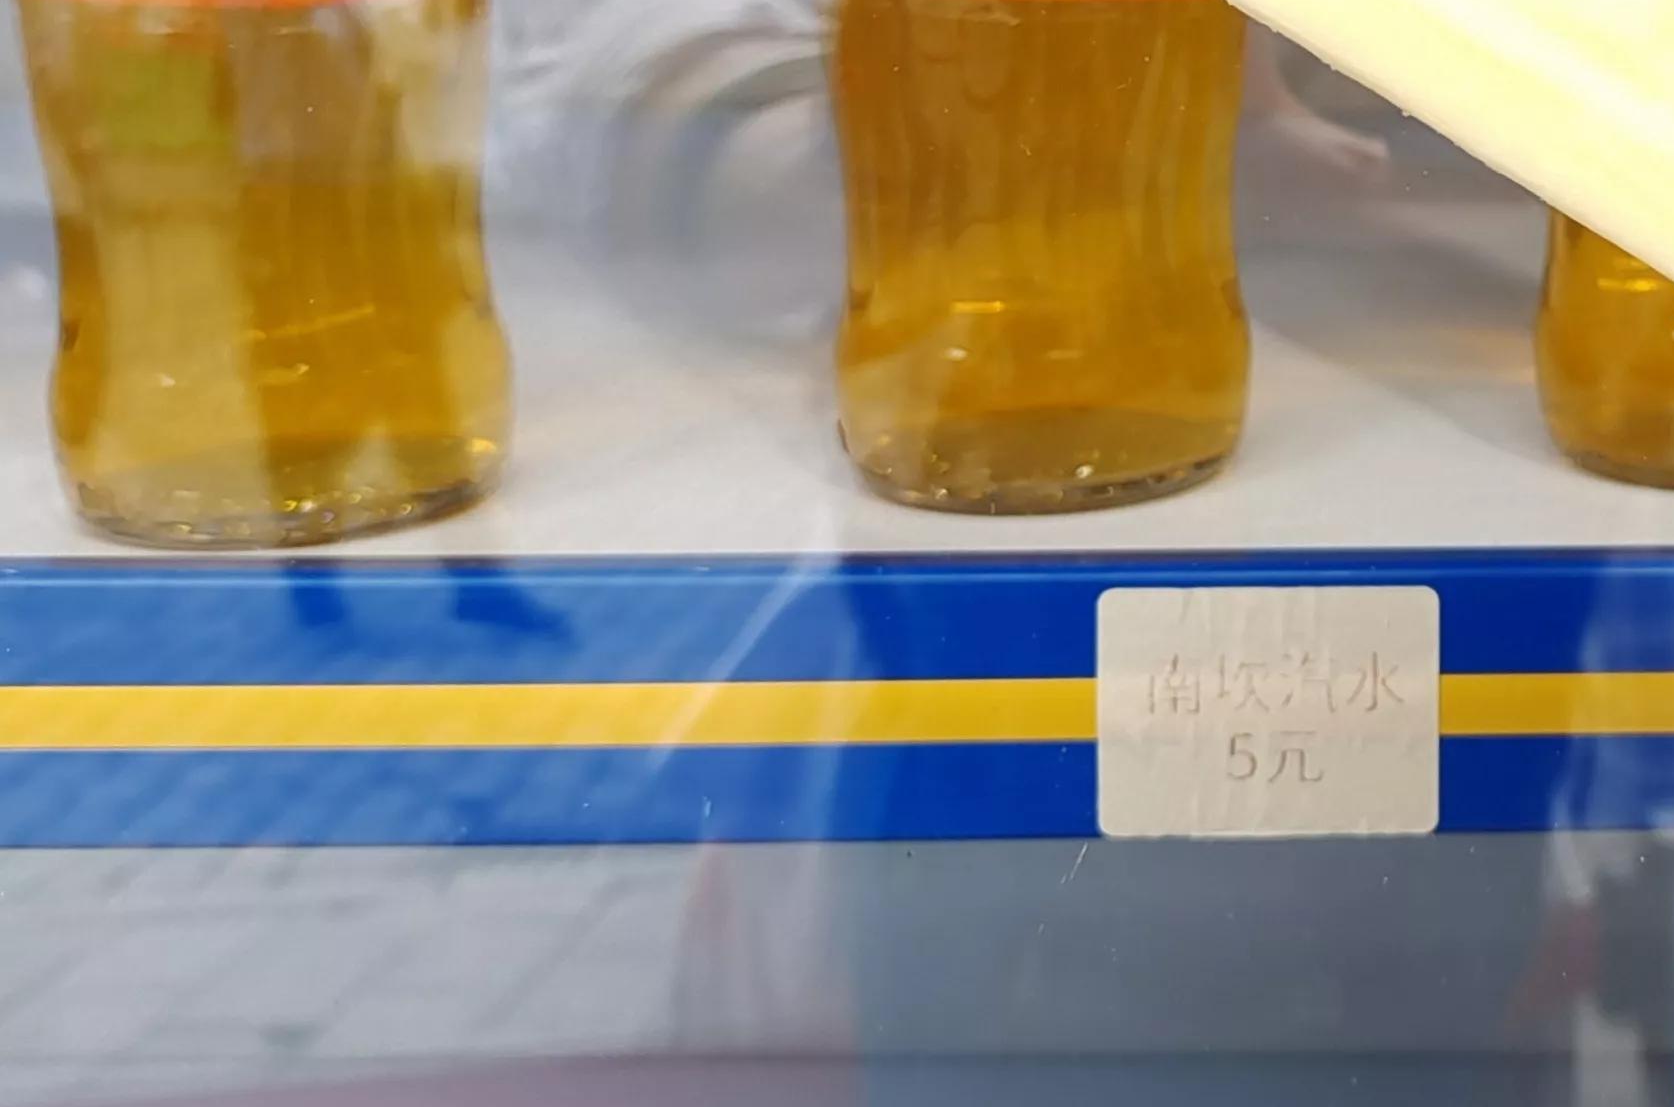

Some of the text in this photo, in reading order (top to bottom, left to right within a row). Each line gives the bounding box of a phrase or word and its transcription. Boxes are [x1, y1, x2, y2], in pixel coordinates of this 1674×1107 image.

[1147, 651, 1406, 715] 南坎汽水
[1226, 731, 1325, 784] 5元
